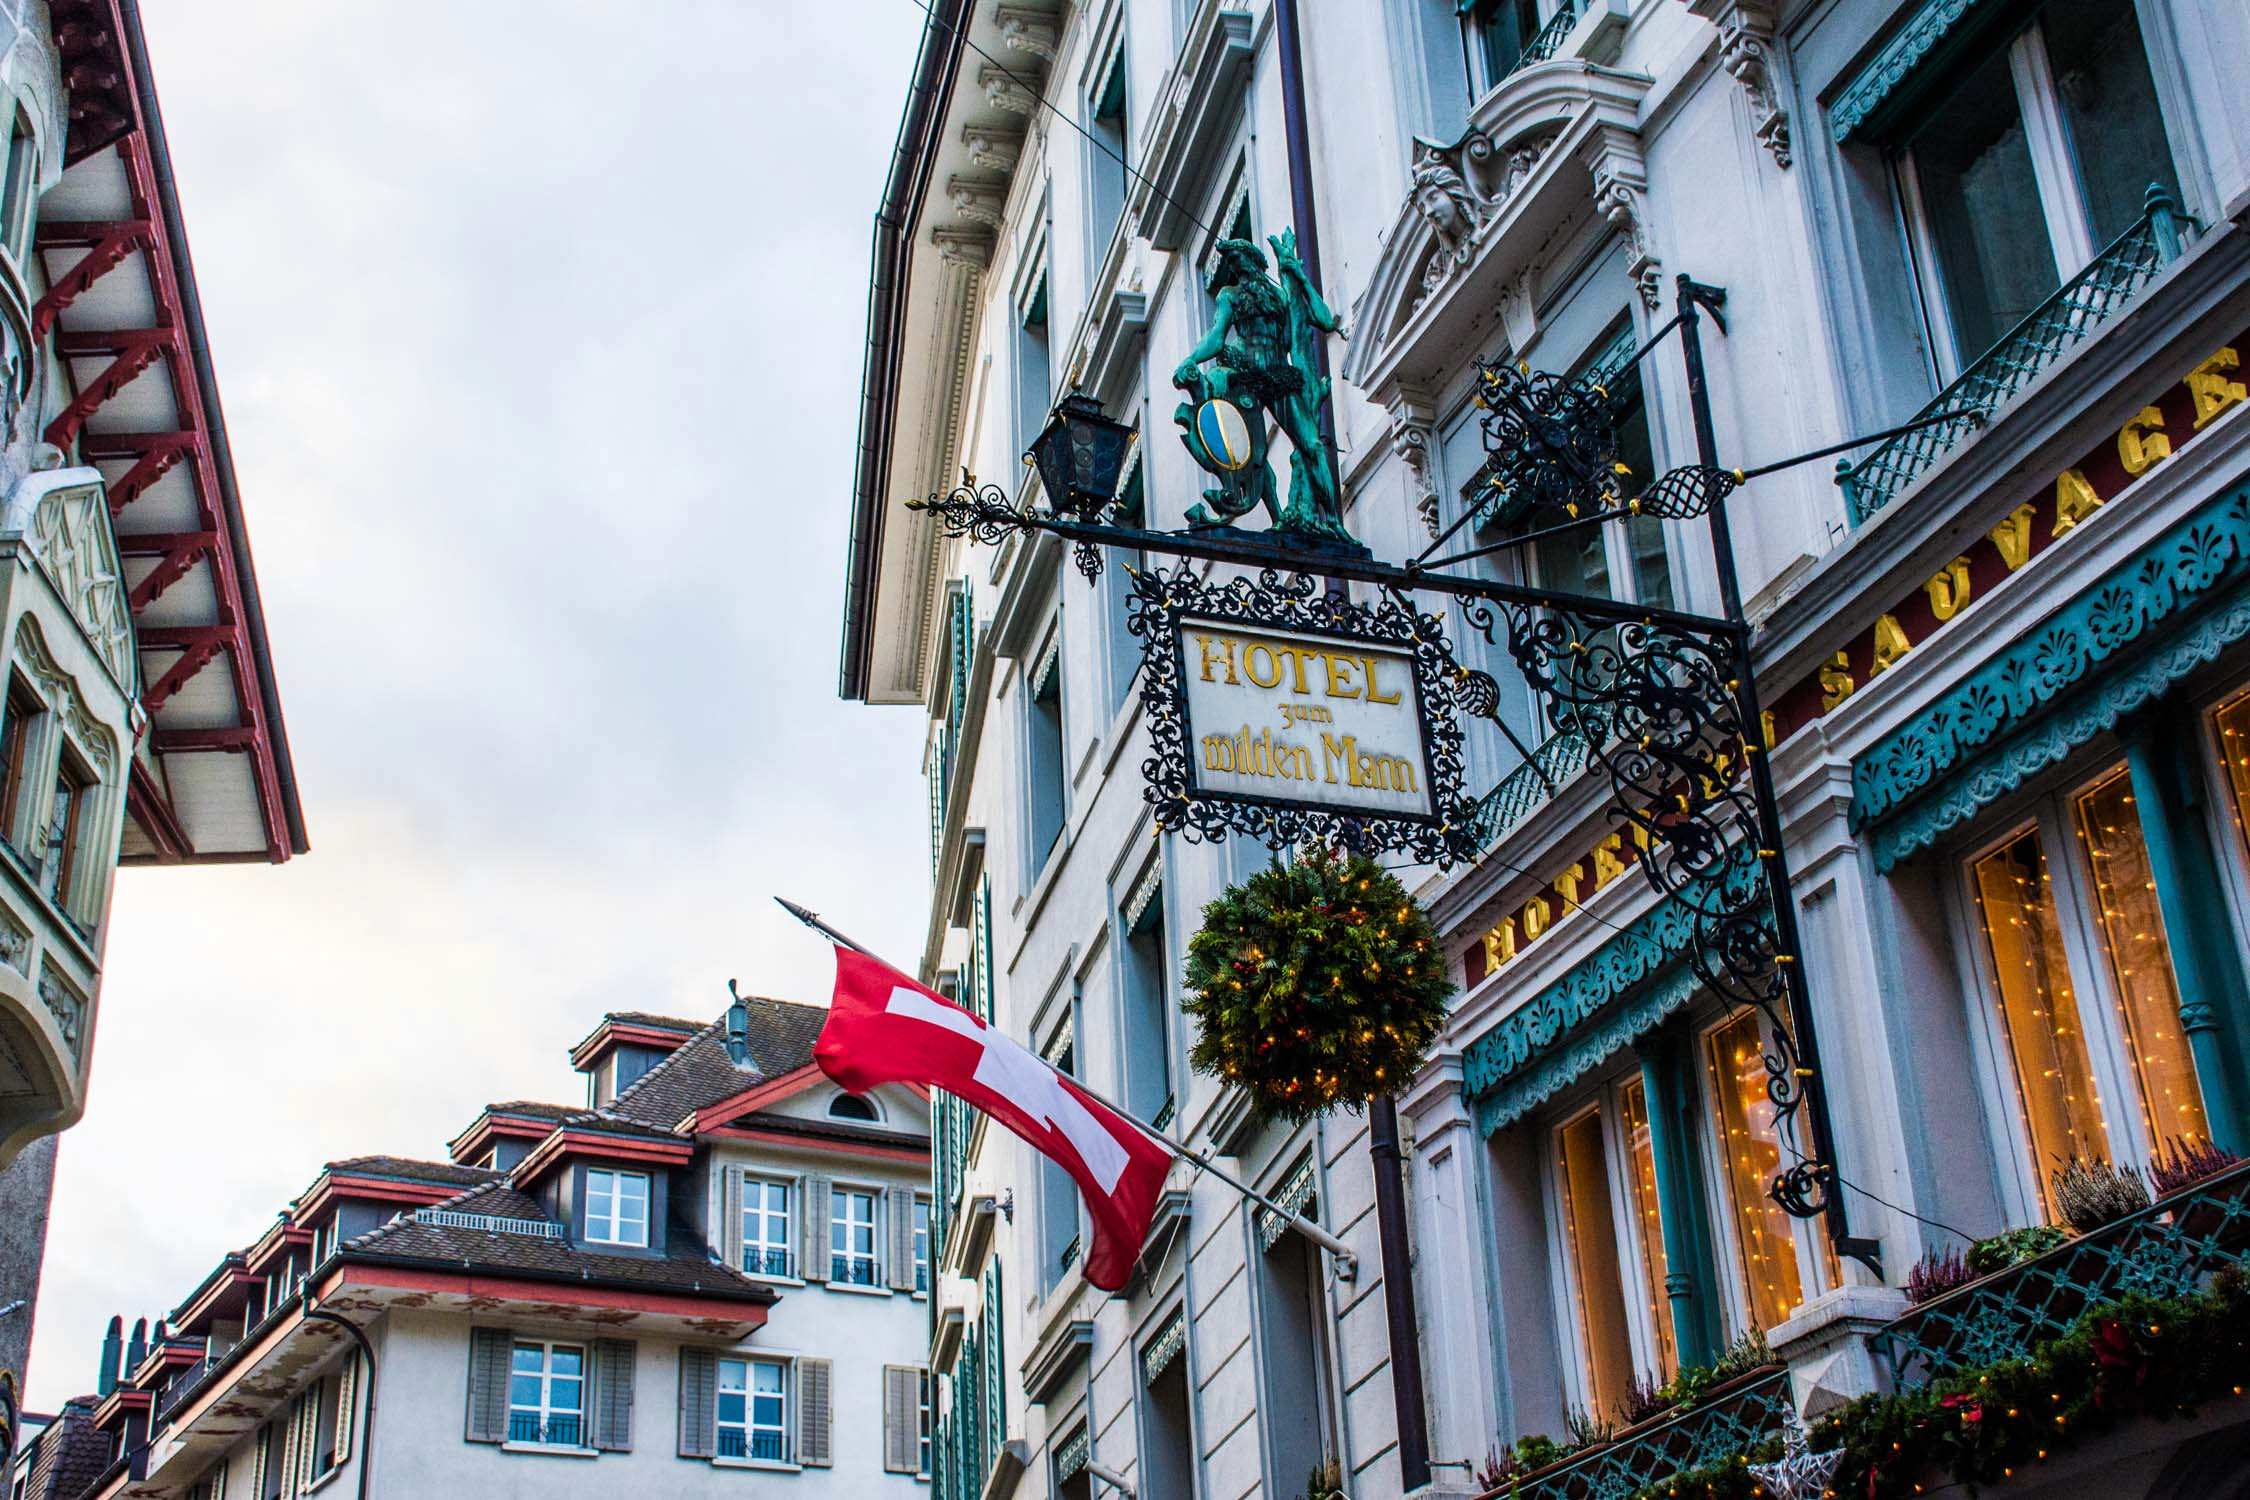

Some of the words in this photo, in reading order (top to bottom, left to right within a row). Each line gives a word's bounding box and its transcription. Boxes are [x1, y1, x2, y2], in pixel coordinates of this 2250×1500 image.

[1819, 346, 2249, 712] SAUVAGE
[1195, 635, 1402, 706] HOTEL
[1277, 702, 1334, 730] zum
[1201, 723, 1316, 783] wilden
[1320, 731, 1418, 794] Mann
